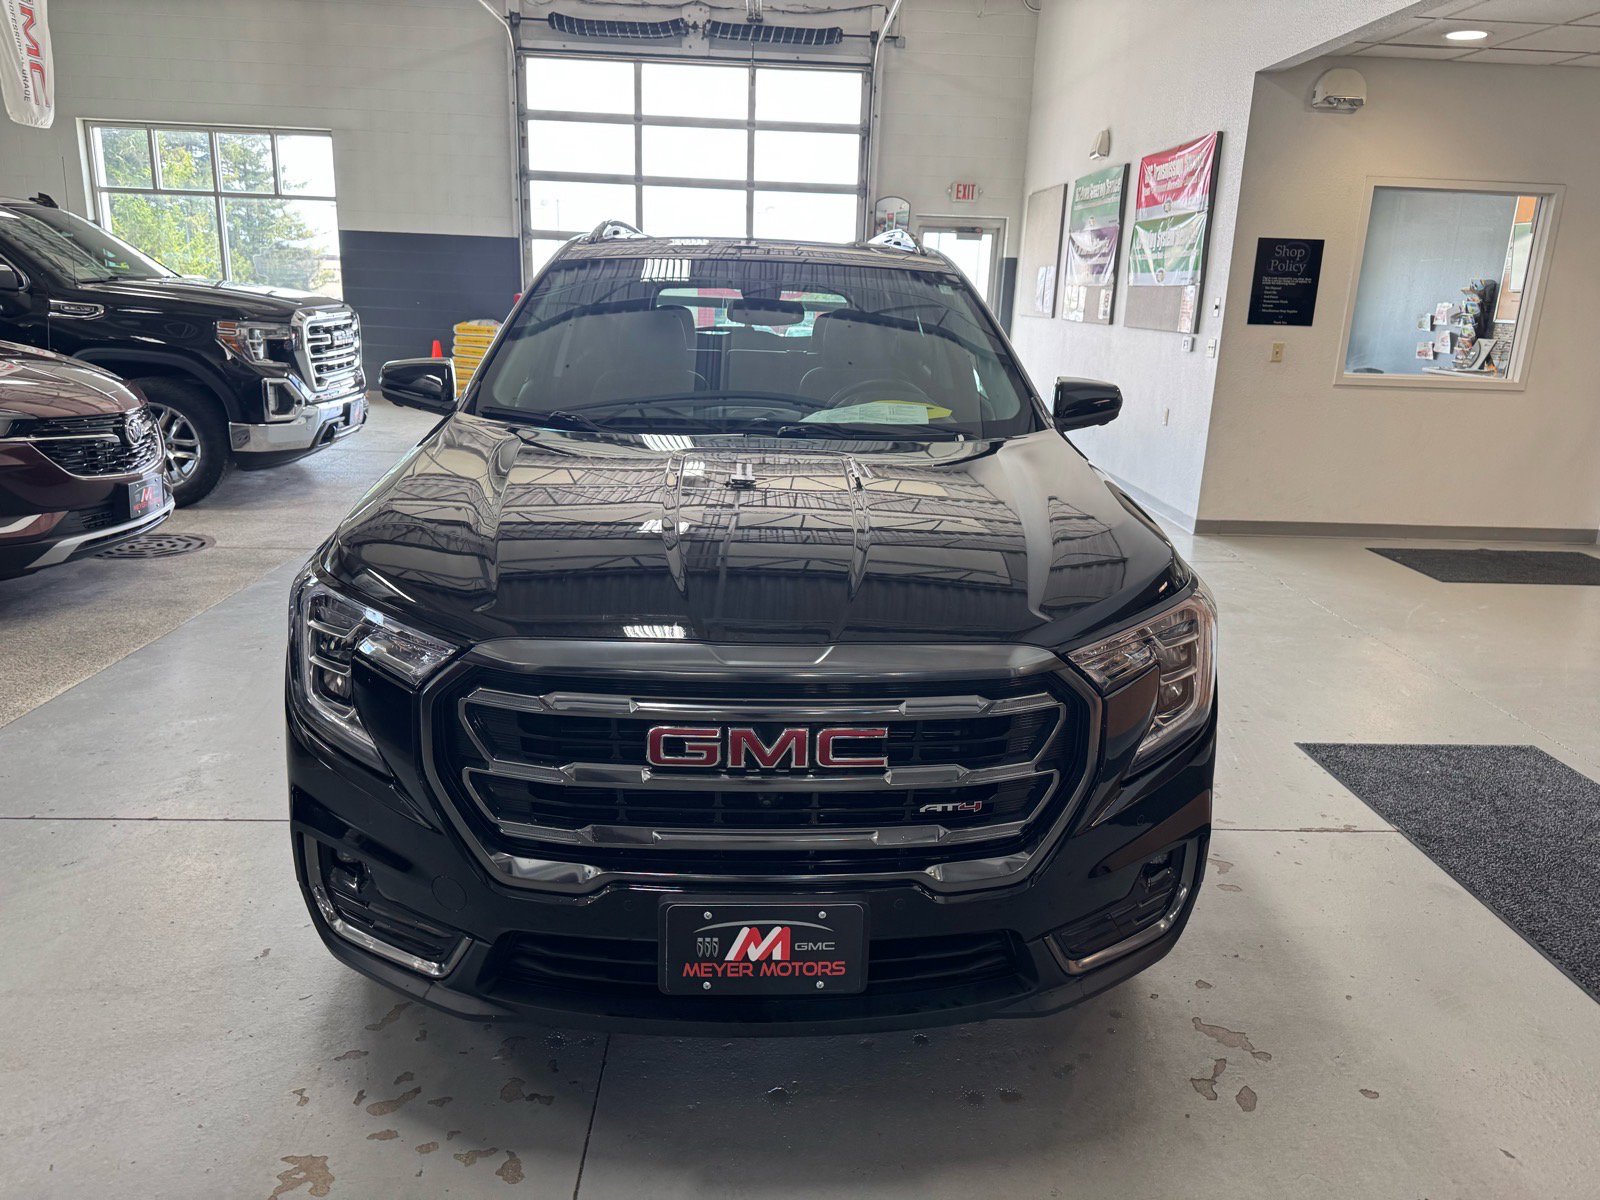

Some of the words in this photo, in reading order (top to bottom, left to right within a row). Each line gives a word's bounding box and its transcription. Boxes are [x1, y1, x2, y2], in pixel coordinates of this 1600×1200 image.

[18, 0, 50, 108] MC
[956, 183, 976, 200] EXIT
[1275, 244, 1305, 260] Shop
[1270, 260, 1307, 275] Policy
[647, 726, 888, 768] GMC
[919, 800, 983, 813] AT4
[794, 942, 836, 950] GMC
[682, 962, 754, 977] MEYER
[759, 961, 846, 977] MOTORS
